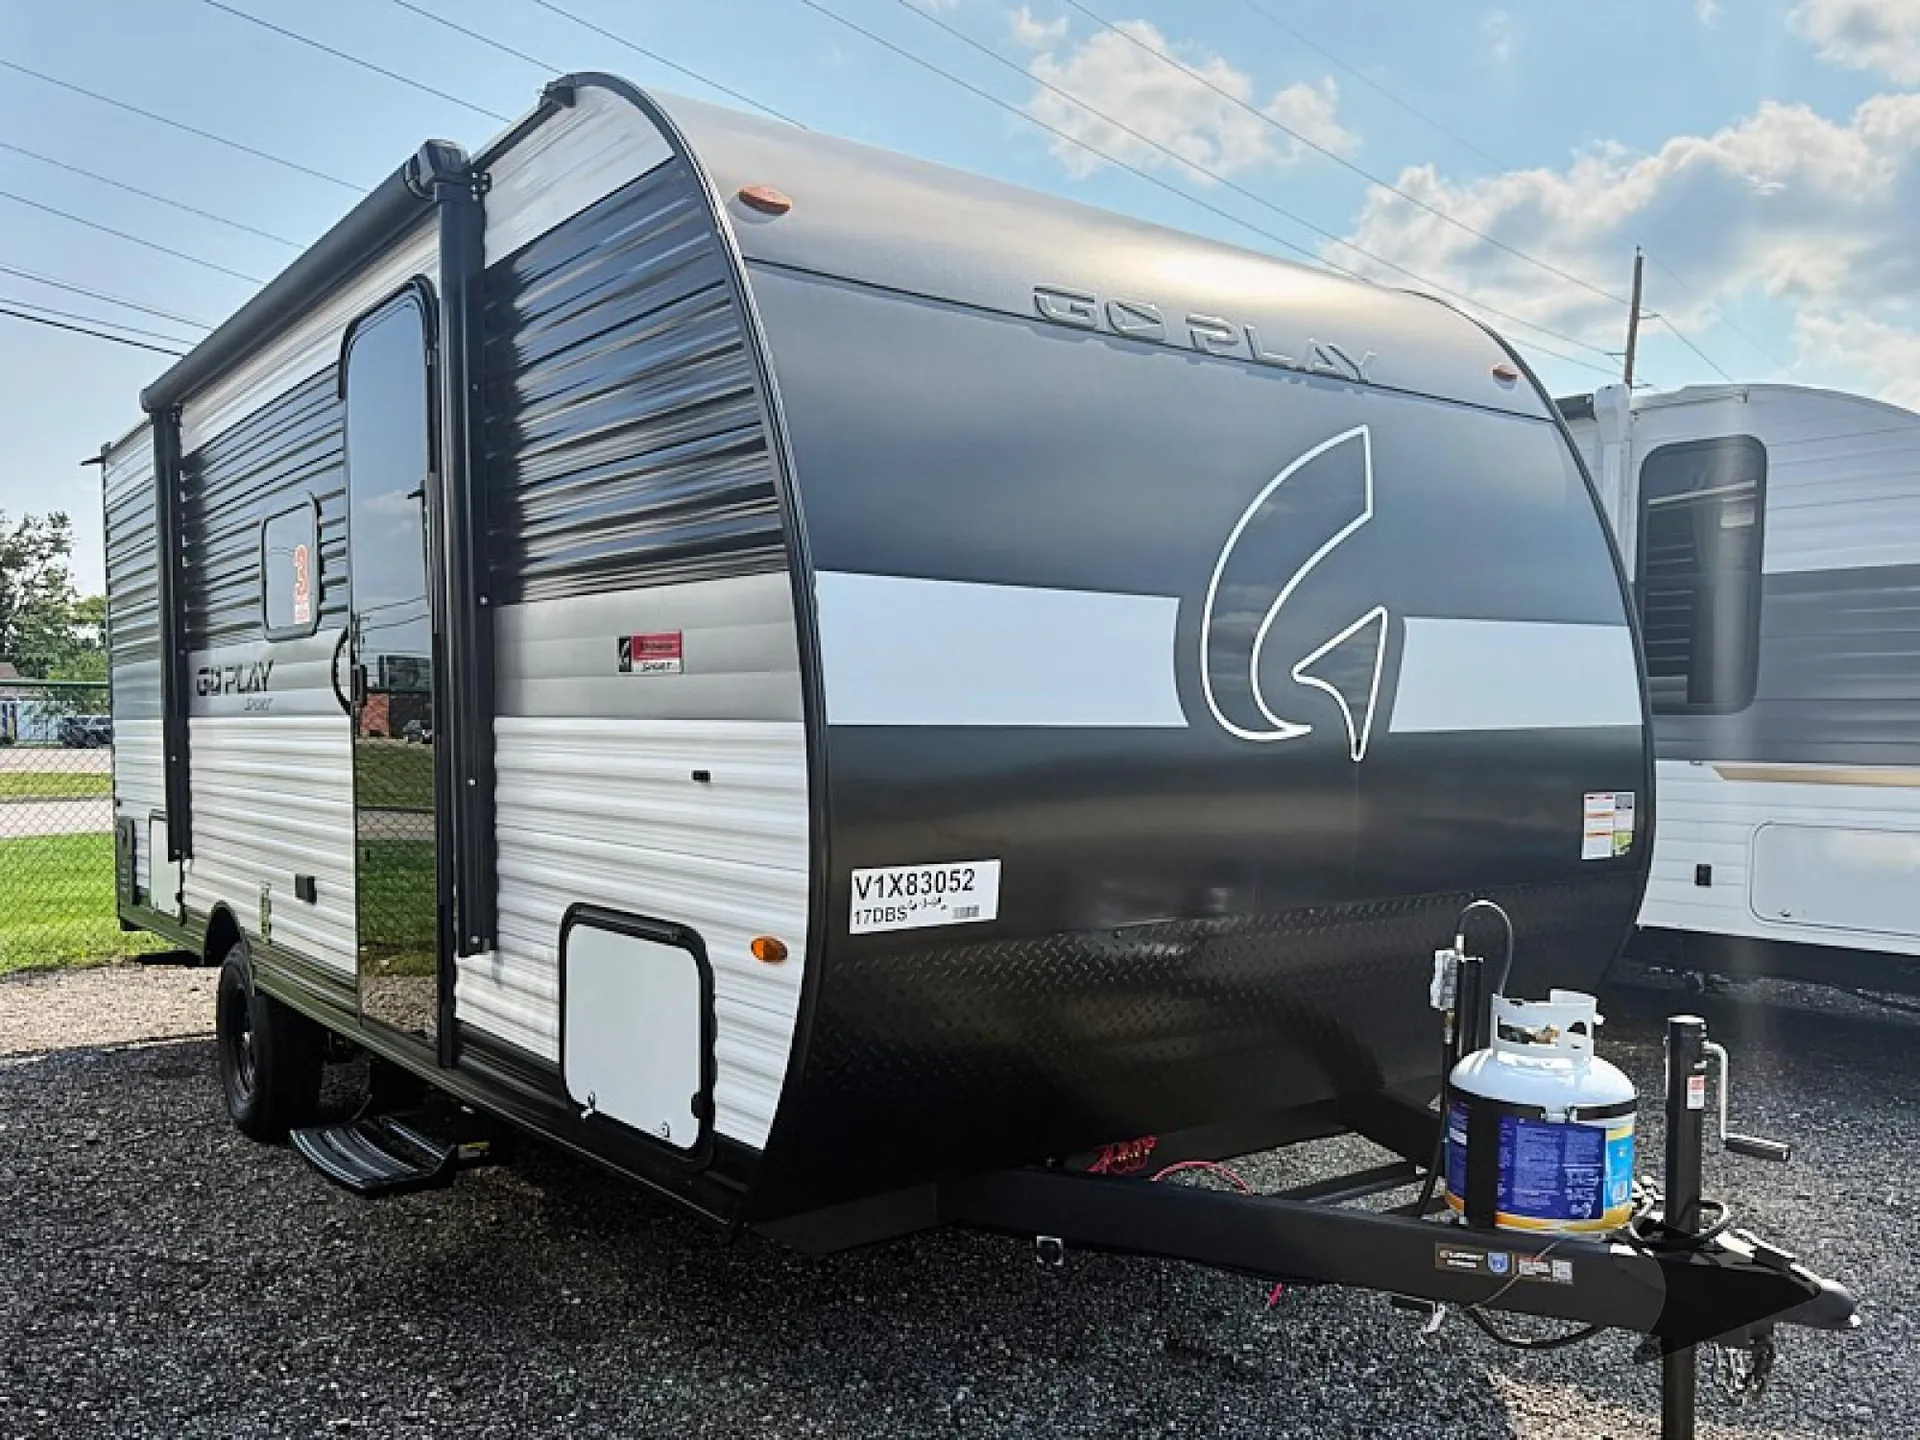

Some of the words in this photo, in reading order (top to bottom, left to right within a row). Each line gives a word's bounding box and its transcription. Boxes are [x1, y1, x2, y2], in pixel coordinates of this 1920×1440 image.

[1032, 283, 1167, 341] GO
[1184, 311, 1377, 385] PLAY
[197, 666, 222, 696] GO
[225, 660, 274, 694] PLAY
[855, 868, 975, 900] V1X83052
